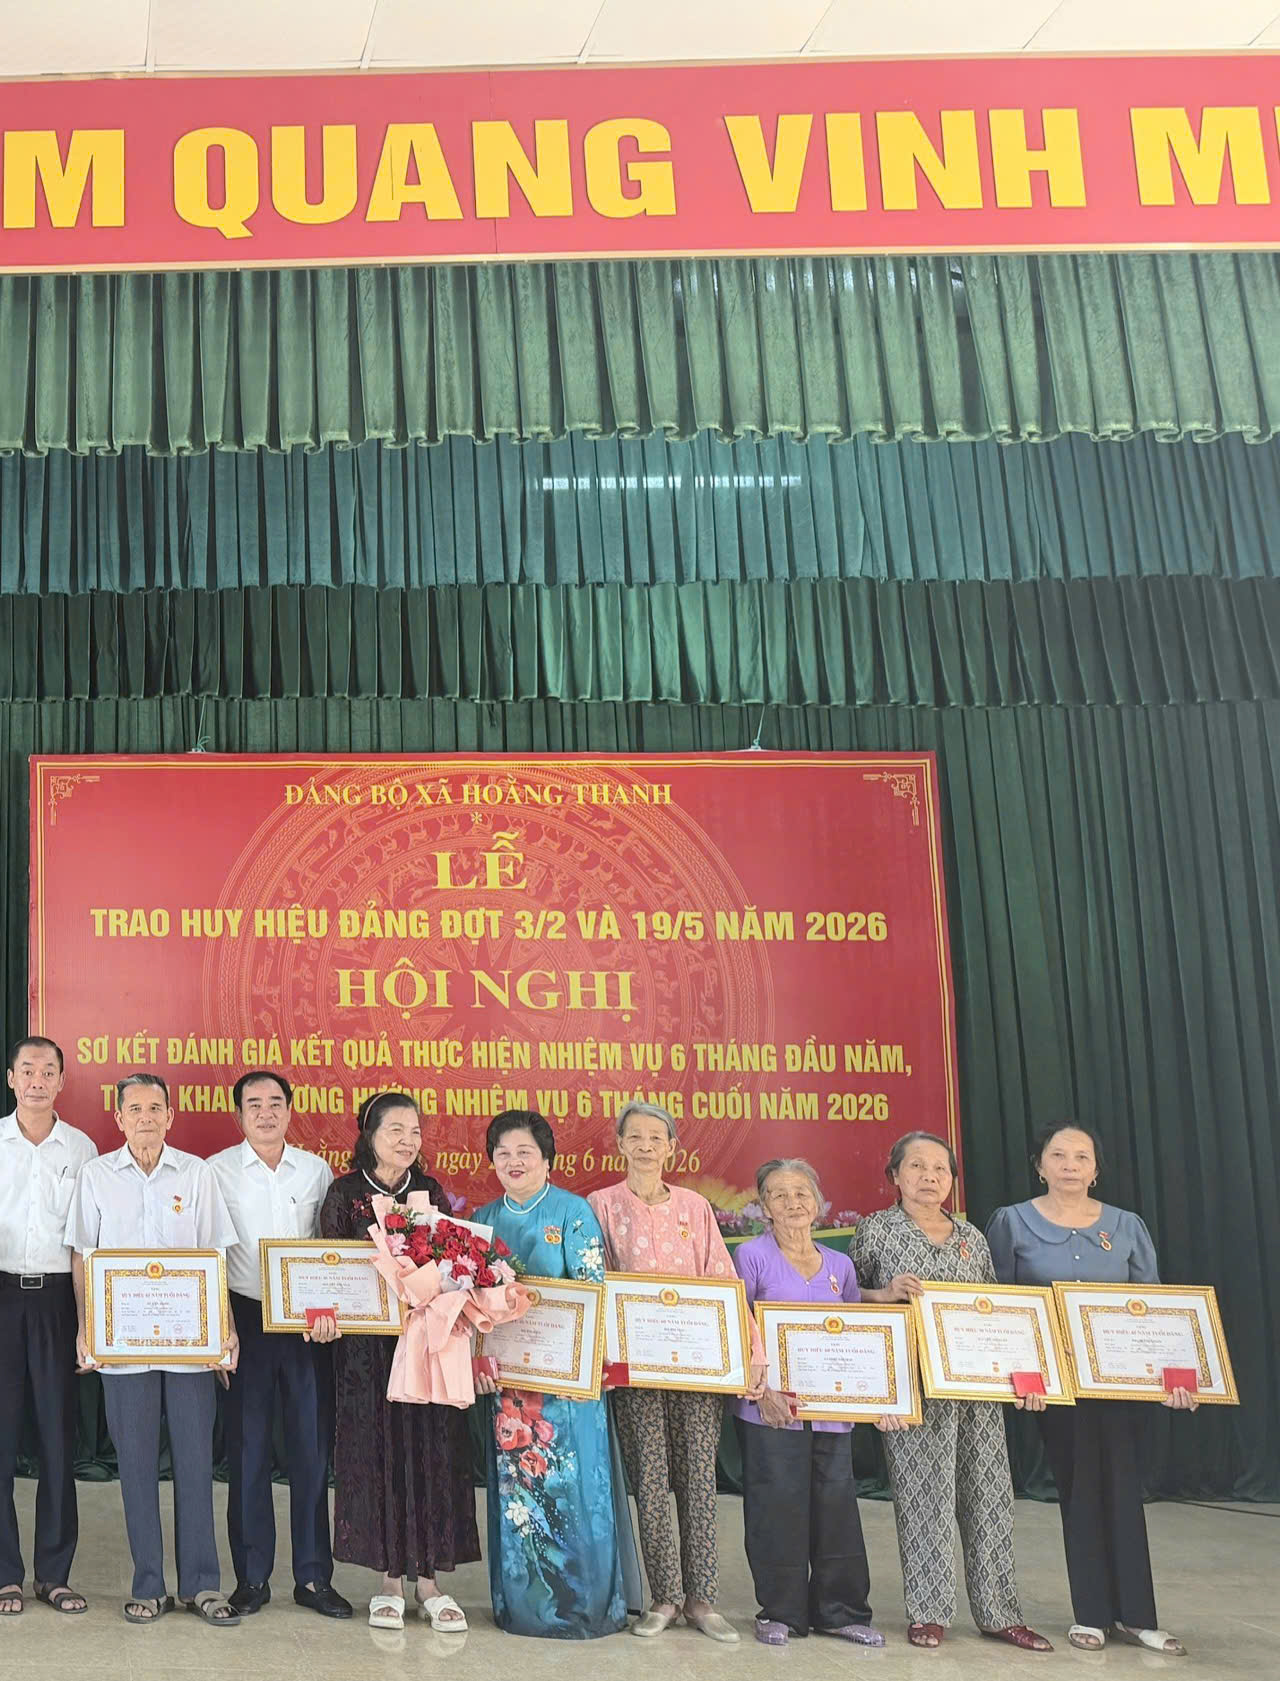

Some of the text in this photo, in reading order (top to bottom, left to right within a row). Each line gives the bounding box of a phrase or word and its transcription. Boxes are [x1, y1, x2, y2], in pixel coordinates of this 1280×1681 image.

[172, 118, 678, 239] QUANG
[724, 108, 1087, 214] VINH
[1130, 106, 1280, 206] M
[284, 774, 672, 811] ĐẢNG BỘ XÃ HOẰNG THANH
[432, 830, 528, 891] LỄ
[90, 899, 888, 945] TRAO HUY HIỆU ĐẢNG ĐỢT 3/2 VÀ 19/5 NĂM 2026
[336, 956, 637, 1023] HỘI NGHỊ
[76, 1030, 913, 1078] SƠ KẾT ĐÁNH GIÁ KẾT QUẢ THỰC HIỆN NHIỆM VỤ 6 THÁNG ĐẦU NĂM,
[535, 1089, 569, 1124] VỤ
[576, 1090, 593, 1118] 6
[691, 1084, 752, 1120] CUỐI
[759, 1087, 820, 1121] NĂM
[827, 1093, 889, 1121] 2026
[436, 1145, 482, 1176] ngày
[583, 1147, 595, 1172] 6
[664, 1149, 701, 1173] 026
